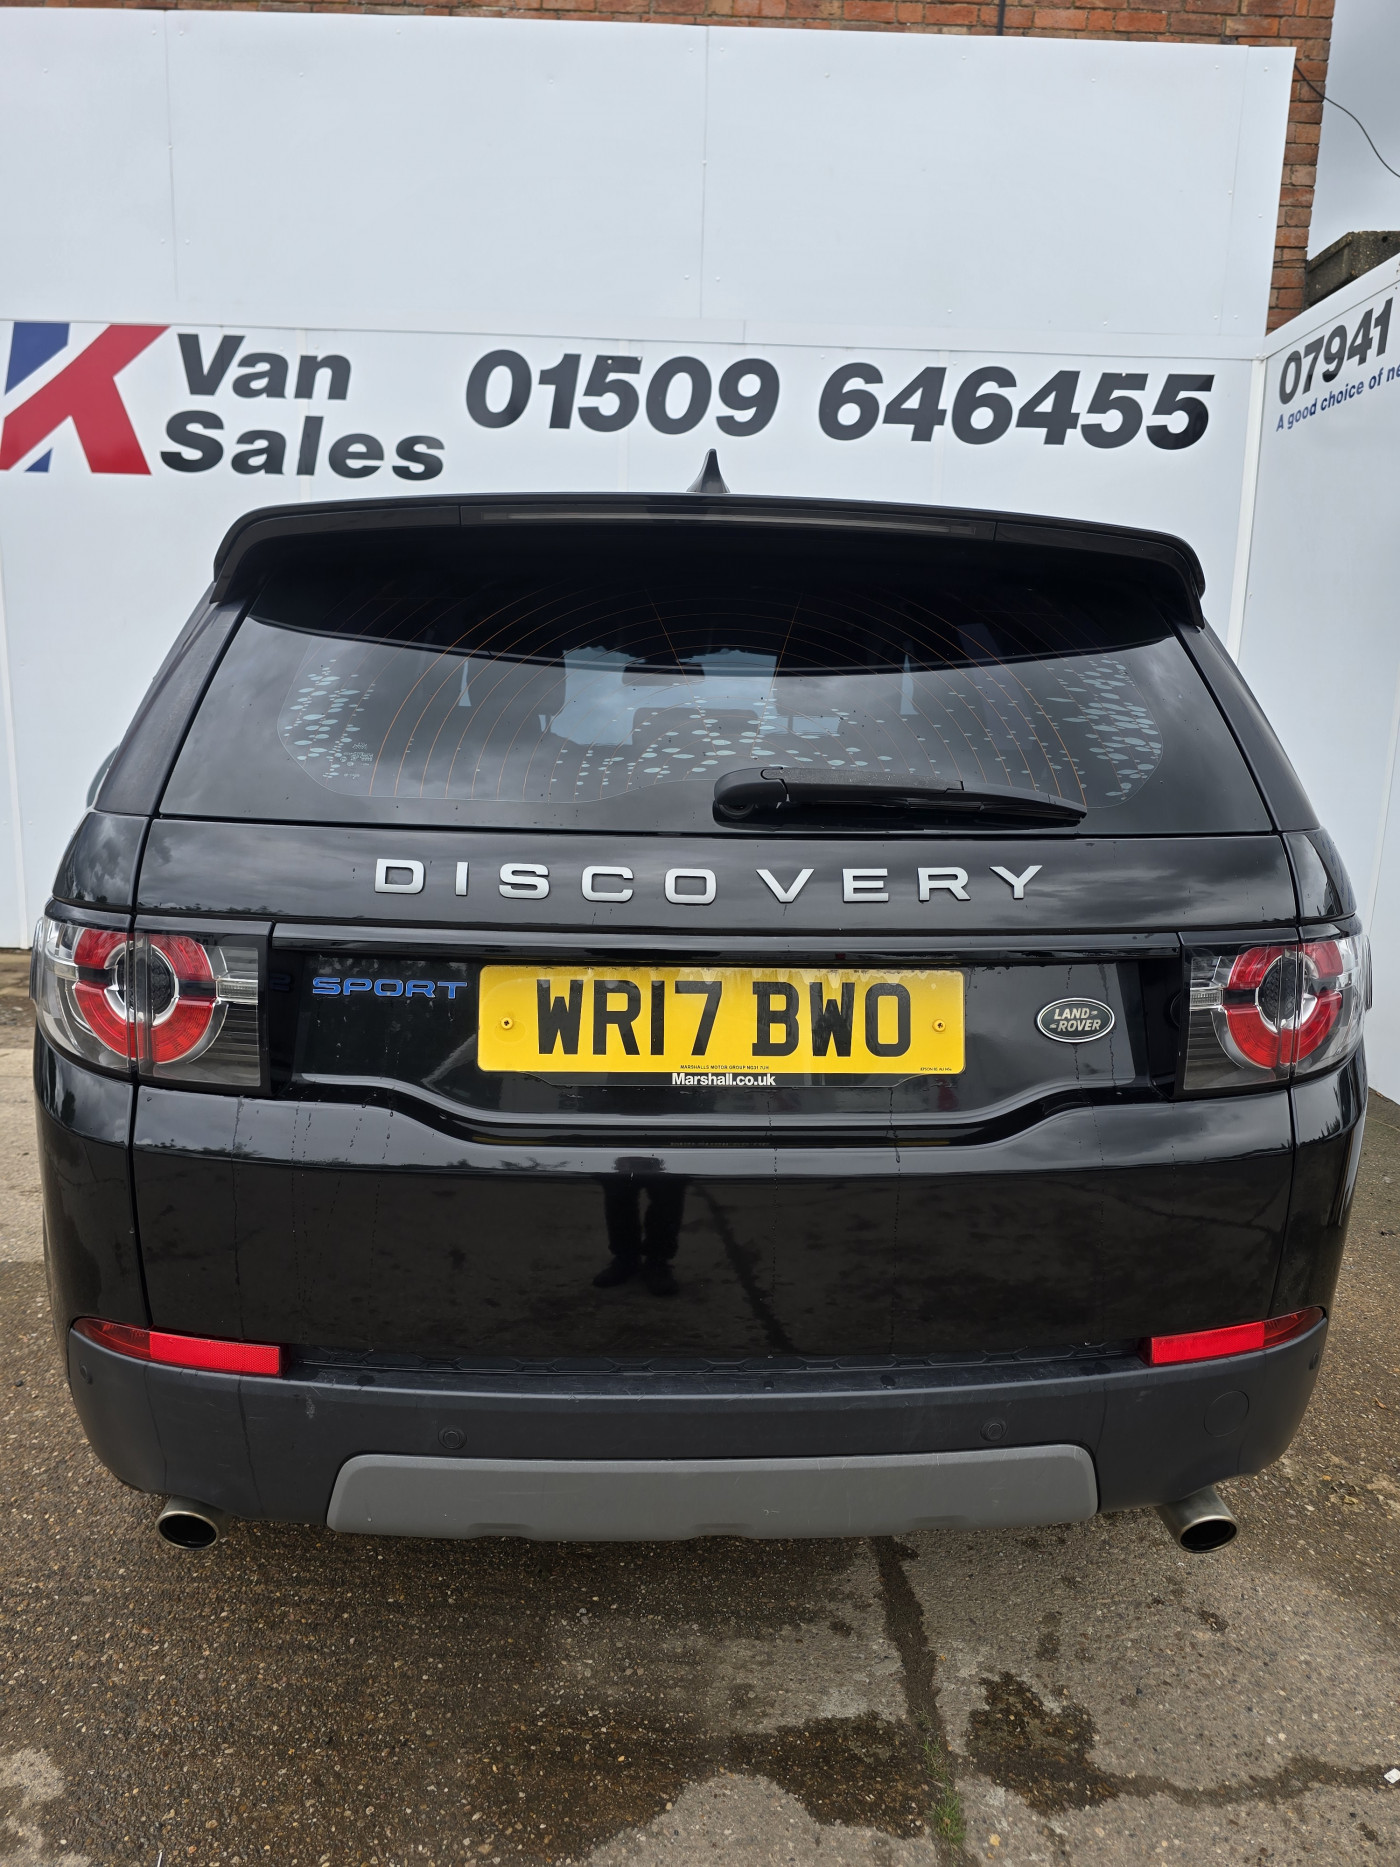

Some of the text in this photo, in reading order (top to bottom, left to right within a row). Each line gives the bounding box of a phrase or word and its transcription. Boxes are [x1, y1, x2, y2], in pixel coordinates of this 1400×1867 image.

[176, 333, 352, 402] Van
[1278, 296, 1394, 405] 07941
[465, 348, 1215, 451] 01509 646455
[1275, 413, 1285, 433] A
[1287, 397, 1318, 430] good
[1320, 381, 1364, 411] choice
[1368, 367, 1384, 390] of
[160, 409, 446, 481] Sales
[374, 857, 1044, 905] DISCOVERY
[312, 976, 468, 999] SPORT
[536, 978, 912, 1058] WR17 BWO
[1053, 1007, 1090, 1020] LAND
[1057, 1019, 1102, 1032] ROVER
[671, 1072, 776, 1086] Marshall.co.uk
